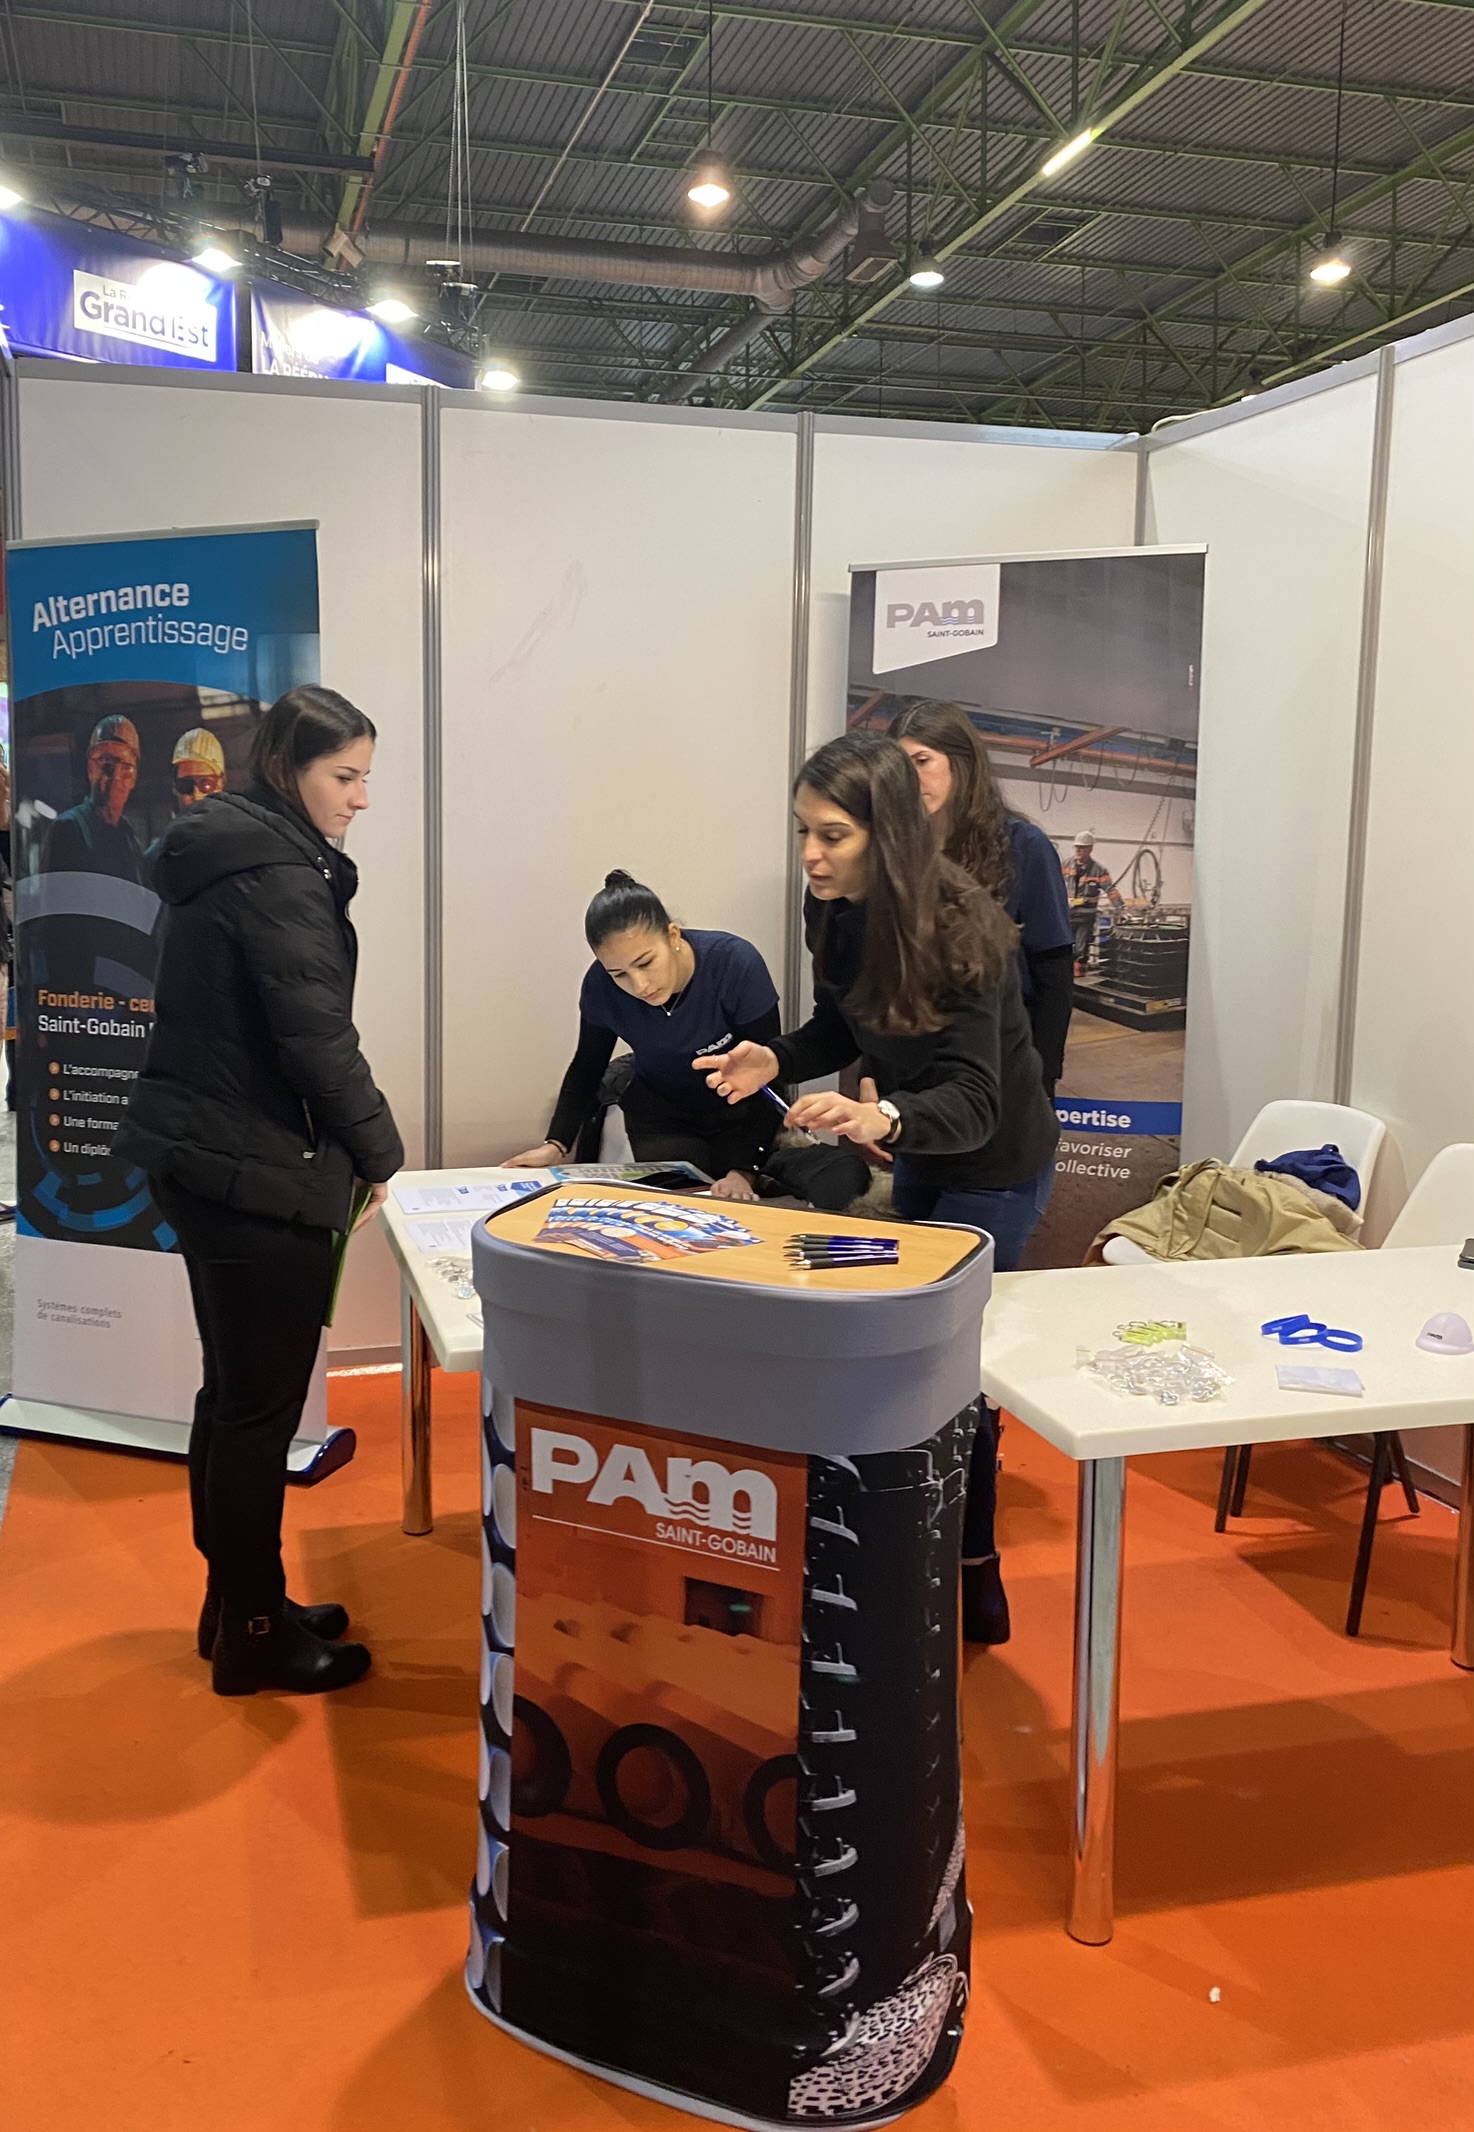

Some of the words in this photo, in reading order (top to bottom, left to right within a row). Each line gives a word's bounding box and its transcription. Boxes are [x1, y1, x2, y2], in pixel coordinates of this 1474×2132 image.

[103, 285, 116, 298] La
[80, 291, 166, 337] Grand
[33, 583, 190, 632] Alternance
[53, 614, 249, 659] Apprentissage
[927, 629, 985, 638] SAINT-GOBAIN
[38, 989, 115, 1010] Fonderie
[38, 1015, 145, 1038] Saint-Gobain
[63, 1089, 120, 1104] L'initiation
[63, 1115, 86, 1128] Une
[63, 1141, 79, 1153] Un
[655, 1522, 777, 1564] SAINT-GOBAIN
